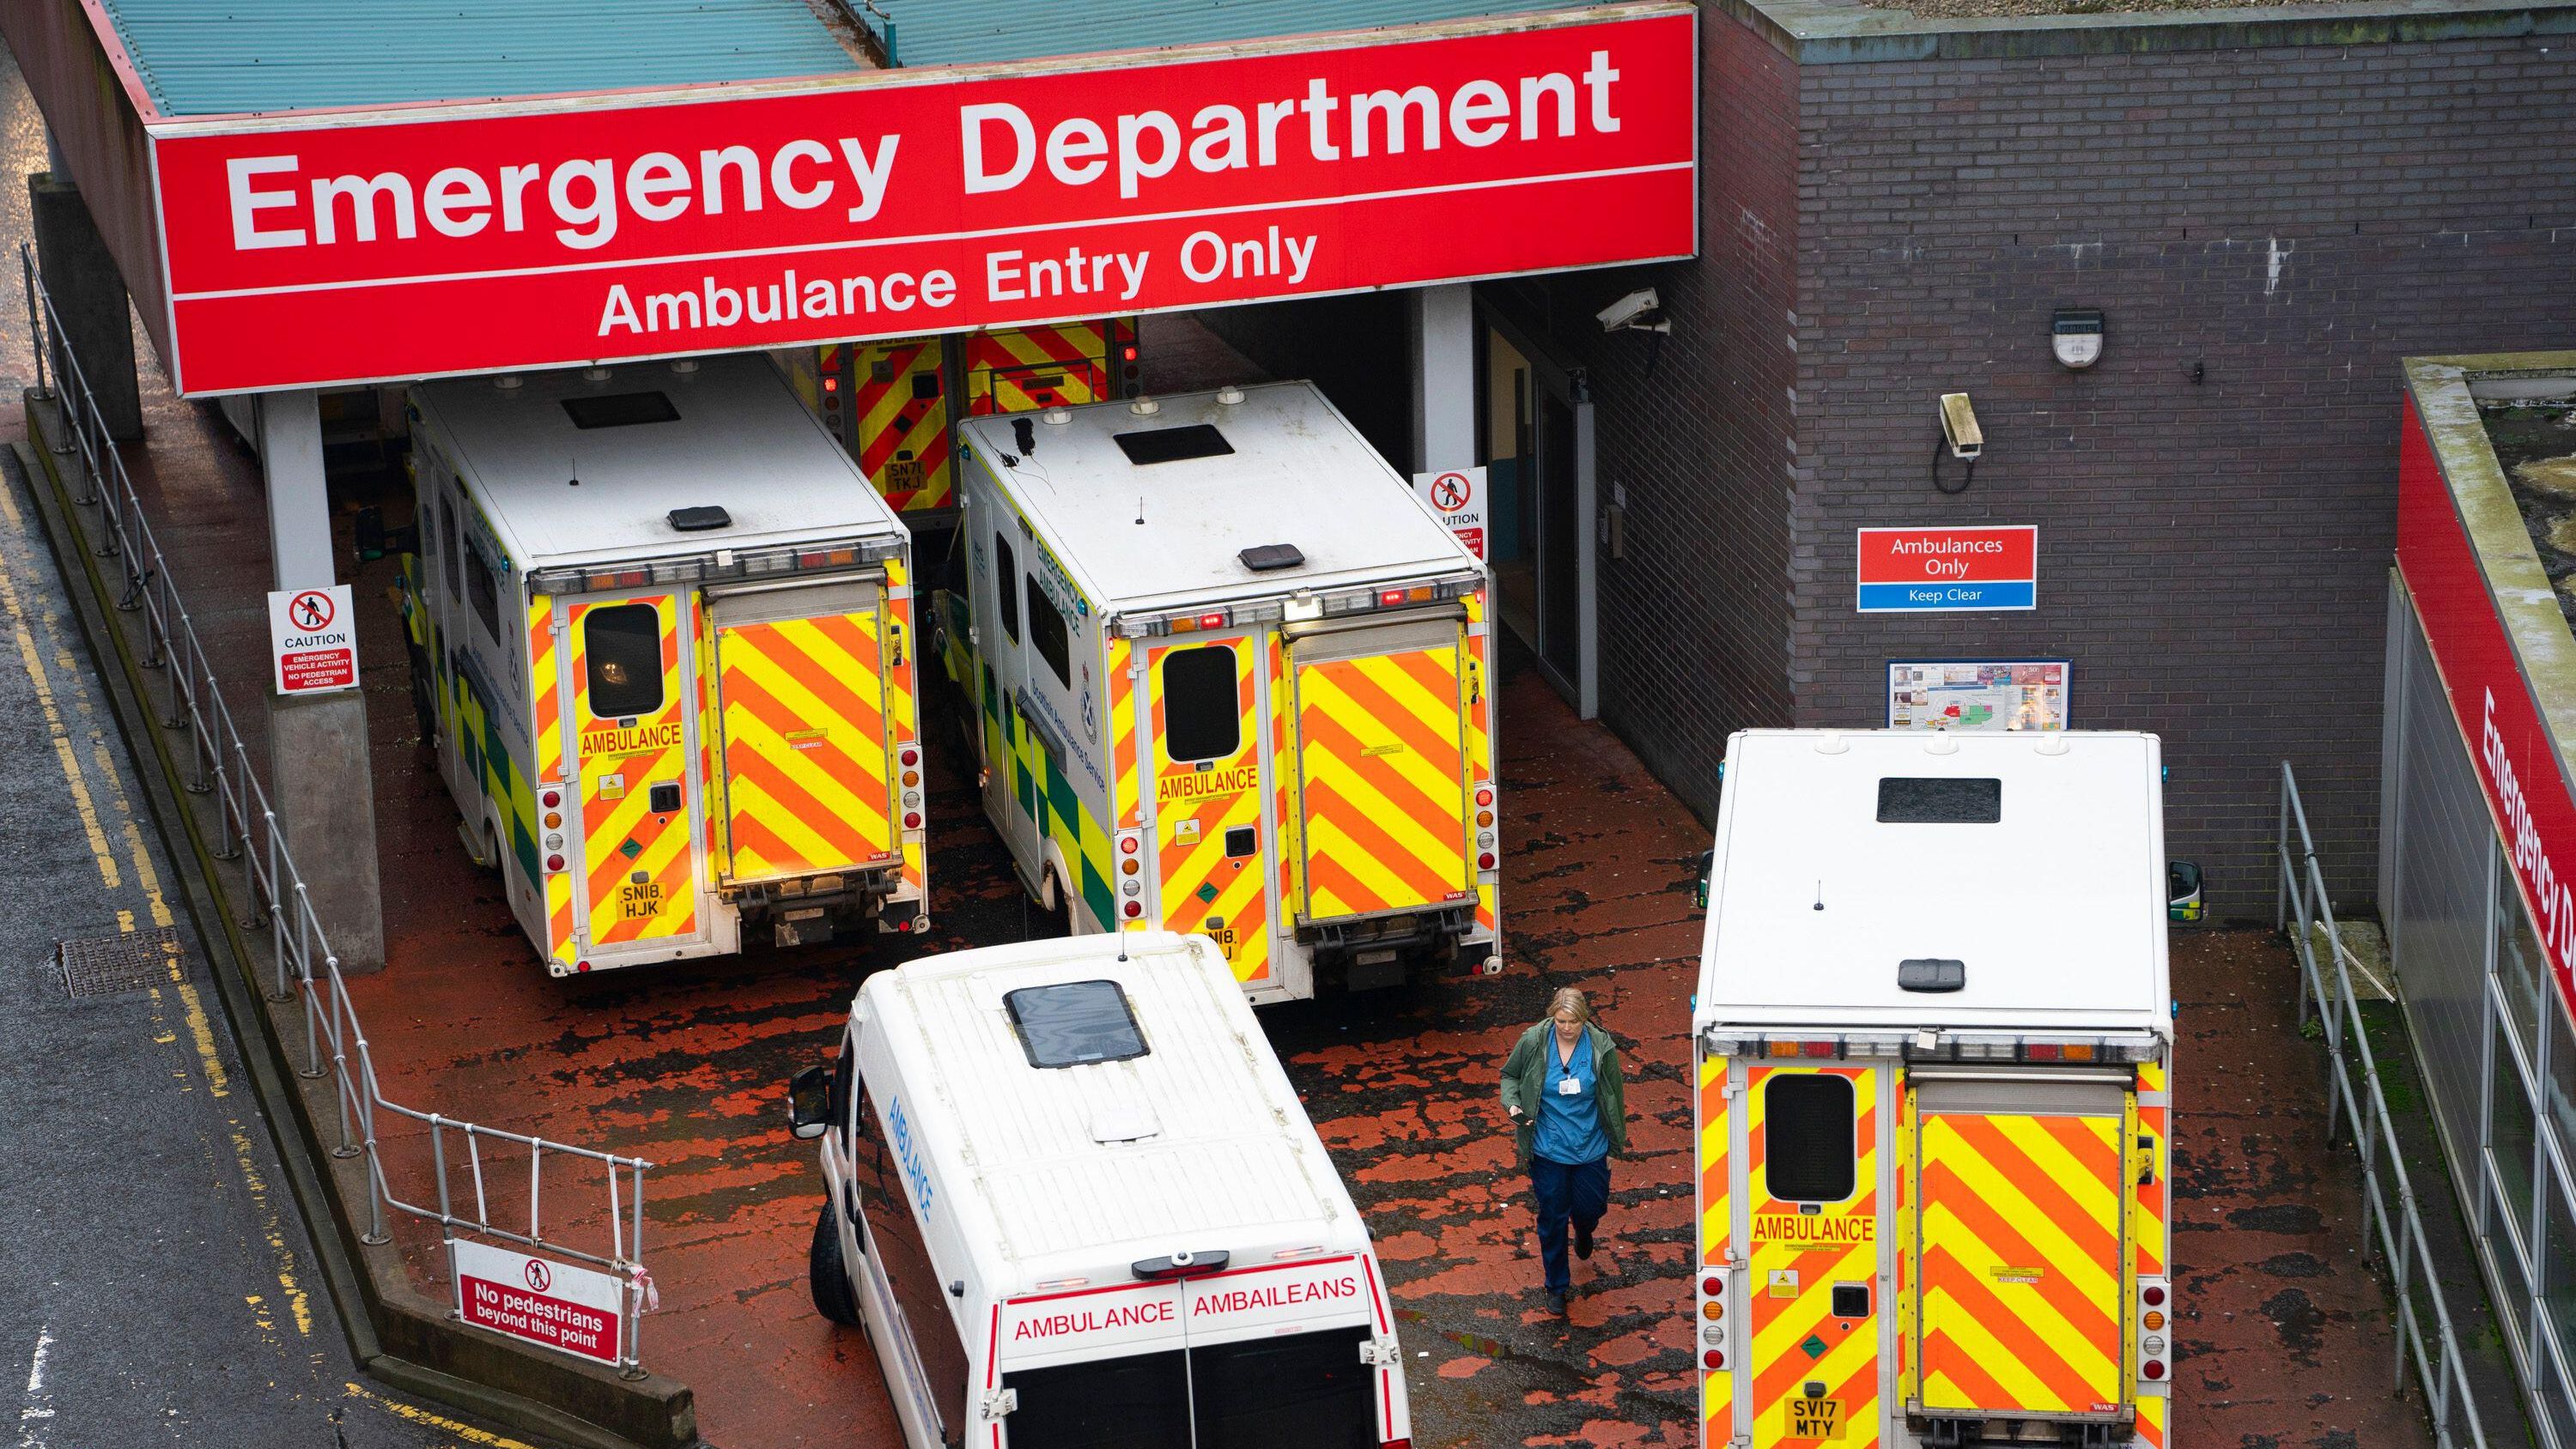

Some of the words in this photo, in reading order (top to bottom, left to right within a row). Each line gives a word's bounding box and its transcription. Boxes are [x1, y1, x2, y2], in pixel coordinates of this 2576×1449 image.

[226, 134, 900, 250] Emergency
[960, 50, 1621, 199] Department
[598, 269, 957, 336] Ambulance
[987, 246, 1150, 300] Entry
[1181, 226, 1318, 284] Only
[1443, 512, 1479, 525] UTION
[1891, 537, 2003, 554] Ambulances
[1036, 537, 1078, 608] EMERGENCY
[1925, 558, 1969, 579] Only
[1039, 567, 1080, 638] AMBULANCE
[1909, 590, 1942, 604] Keep
[1947, 588, 1982, 601] Clear
[284, 634, 345, 648] CAUTION
[293, 653, 340, 663] EMERGENCY
[317, 658, 349, 668] ACTIVITY
[301, 669, 348, 679] PEDESTRIAN
[303, 677, 334, 686] ACCESS
[582, 724, 681, 755] AMBULANCE
[1160, 768, 1257, 799] AMBULANCE
[2483, 684, 2560, 948] Emergency
[623, 884, 659, 900] SN18
[626, 900, 658, 918] HJK
[1208, 930, 1233, 944] N18
[889, 1094, 933, 1223] AMBULANCE
[1753, 1216, 1874, 1241] AMBULANCE
[475, 1282, 498, 1304] No
[504, 1294, 603, 1331] pedestrians
[1015, 1300, 1175, 1340] AMBULANCE
[1194, 1276, 1356, 1316] AMBAILEANS
[476, 1302, 527, 1330] beyond
[531, 1318, 557, 1337] this
[561, 1328, 597, 1349] point
[1794, 1400, 1837, 1417] SV17
[1796, 1420, 1834, 1436] MTY
